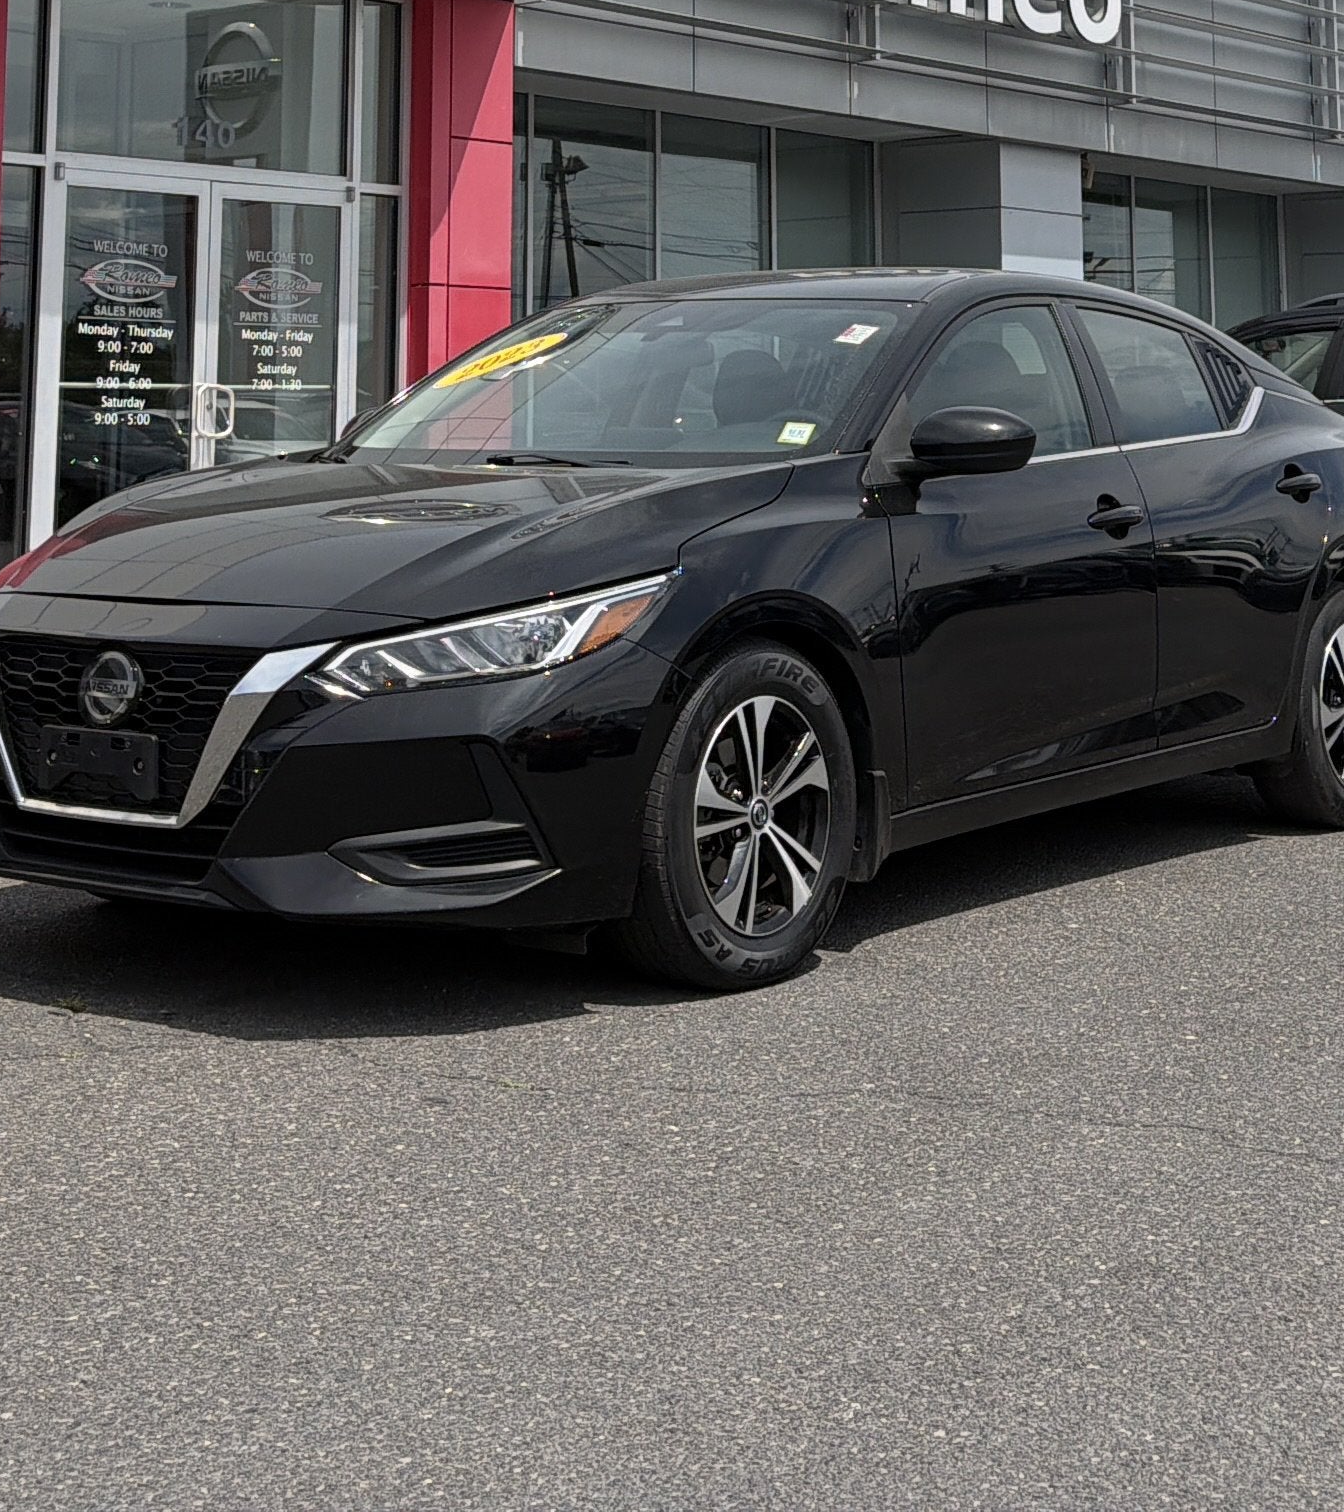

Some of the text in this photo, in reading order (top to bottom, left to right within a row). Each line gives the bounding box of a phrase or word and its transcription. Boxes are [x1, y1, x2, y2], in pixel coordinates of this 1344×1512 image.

[176, 116, 236, 148] 140
[93, 240, 168, 258] WELCOME TO
[246, 250, 314, 265] WELCOME TO
[102, 262, 161, 285] Romeo
[255, 271, 309, 292] Romeo
[107, 285, 150, 296] NISSAN
[259, 293, 298, 301] NISSAN
[94, 304, 163, 319] SALES HOURS
[239, 311, 269, 322] PARTS
[281, 312, 319, 324] SERVICE
[78, 322, 119, 338] Monday
[127, 324, 174, 340] Thursday
[241, 329, 278, 342] Monday
[285, 330, 314, 344] Friday
[97, 340, 121, 353] 9:00
[130, 342, 154, 354] 7:00
[252, 345, 274, 356] 7:00
[281, 346, 303, 357] 5:00
[109, 360, 141, 375] Friday
[257, 362, 297, 376] Saturday
[96, 377, 120, 389] 9:00
[128, 377, 152, 390] 6:00
[251, 379, 273, 390] 7:00
[281, 379, 302, 390] 1:30
[101, 396, 146, 411] Saturday
[94, 413, 118, 425] 9:00
[127, 413, 151, 426] 5:00
